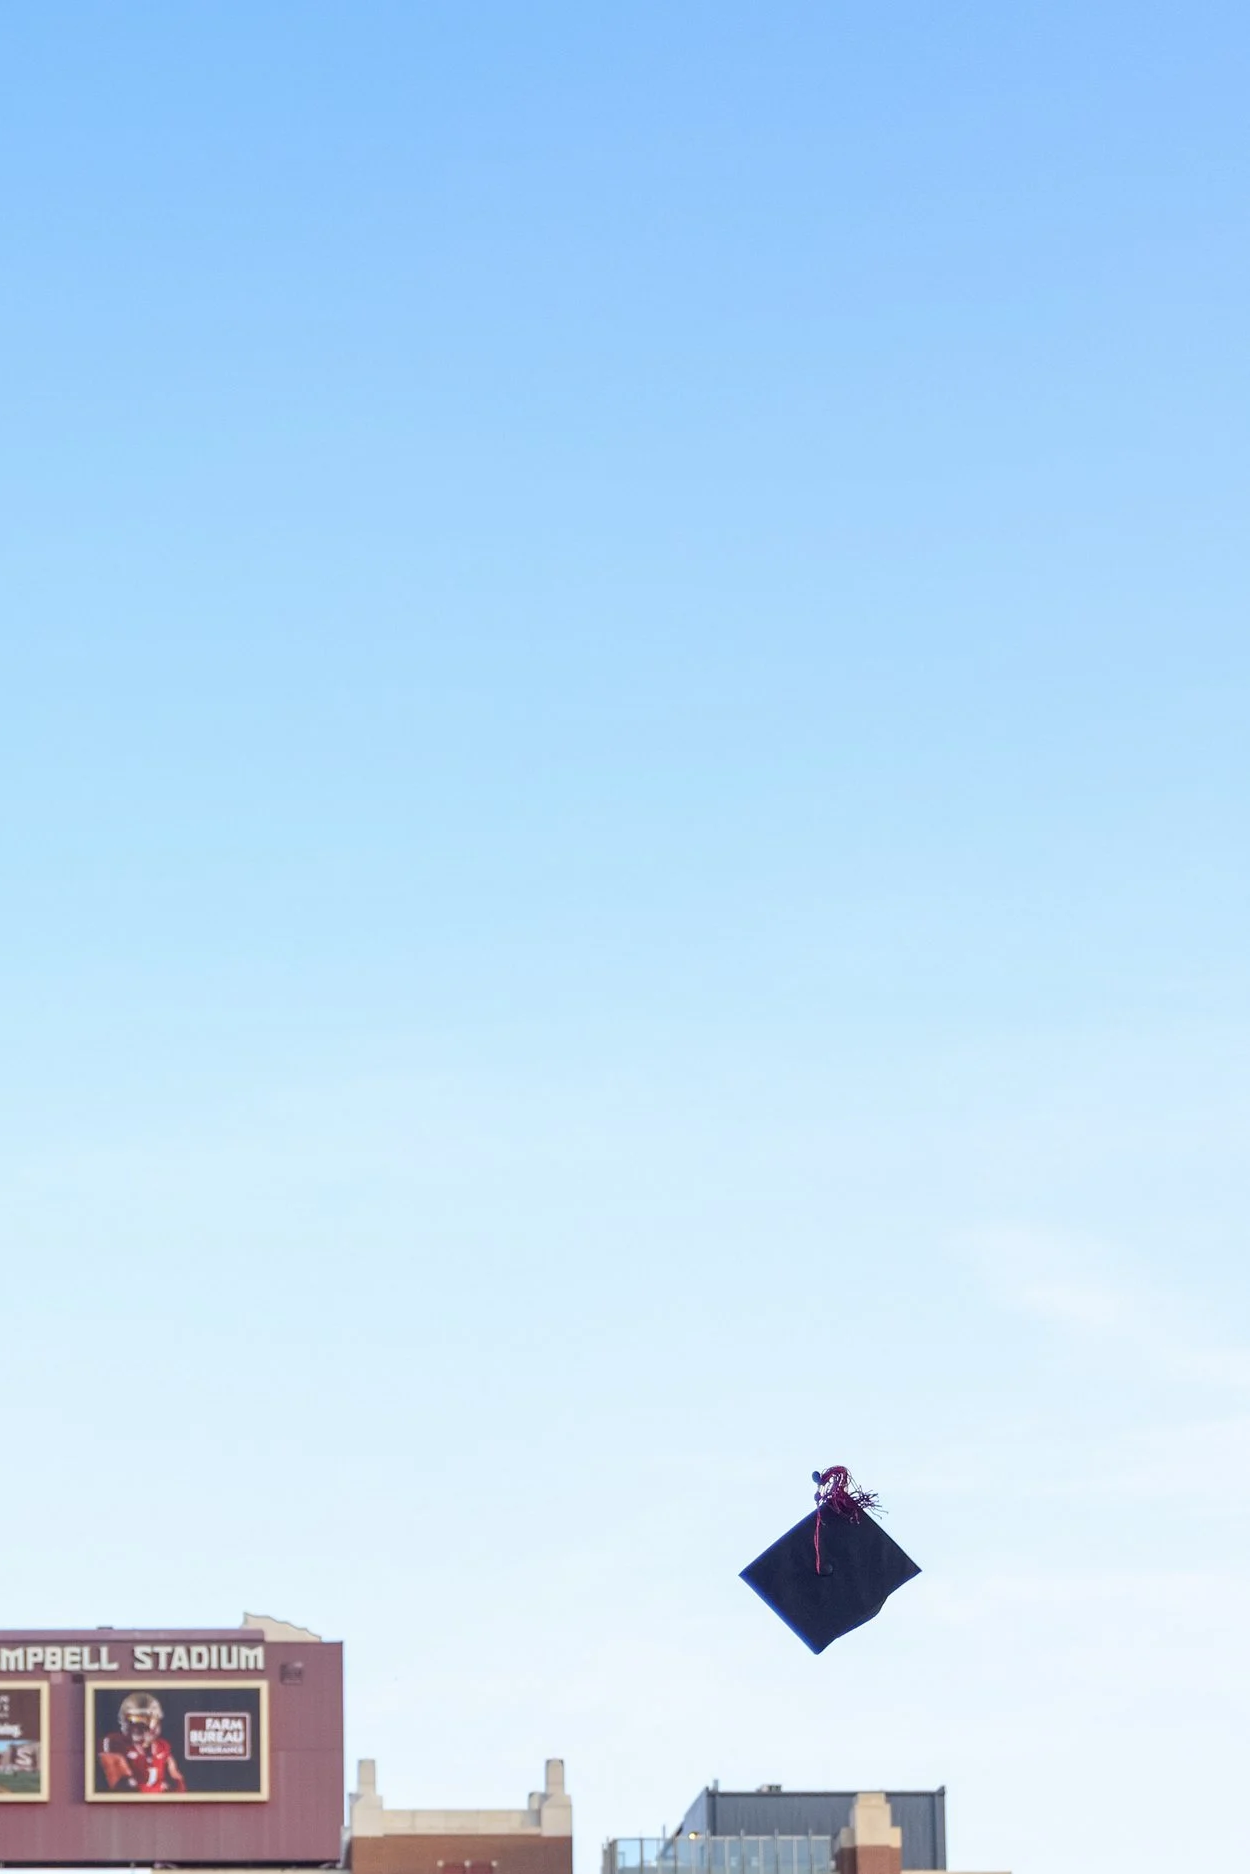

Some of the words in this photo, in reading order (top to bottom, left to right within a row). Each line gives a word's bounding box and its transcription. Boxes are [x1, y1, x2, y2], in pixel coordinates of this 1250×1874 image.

[134, 1646, 265, 1670] STADIUM
[205, 1718, 243, 1730] FARM
[190, 1730, 245, 1743] BUREAU
